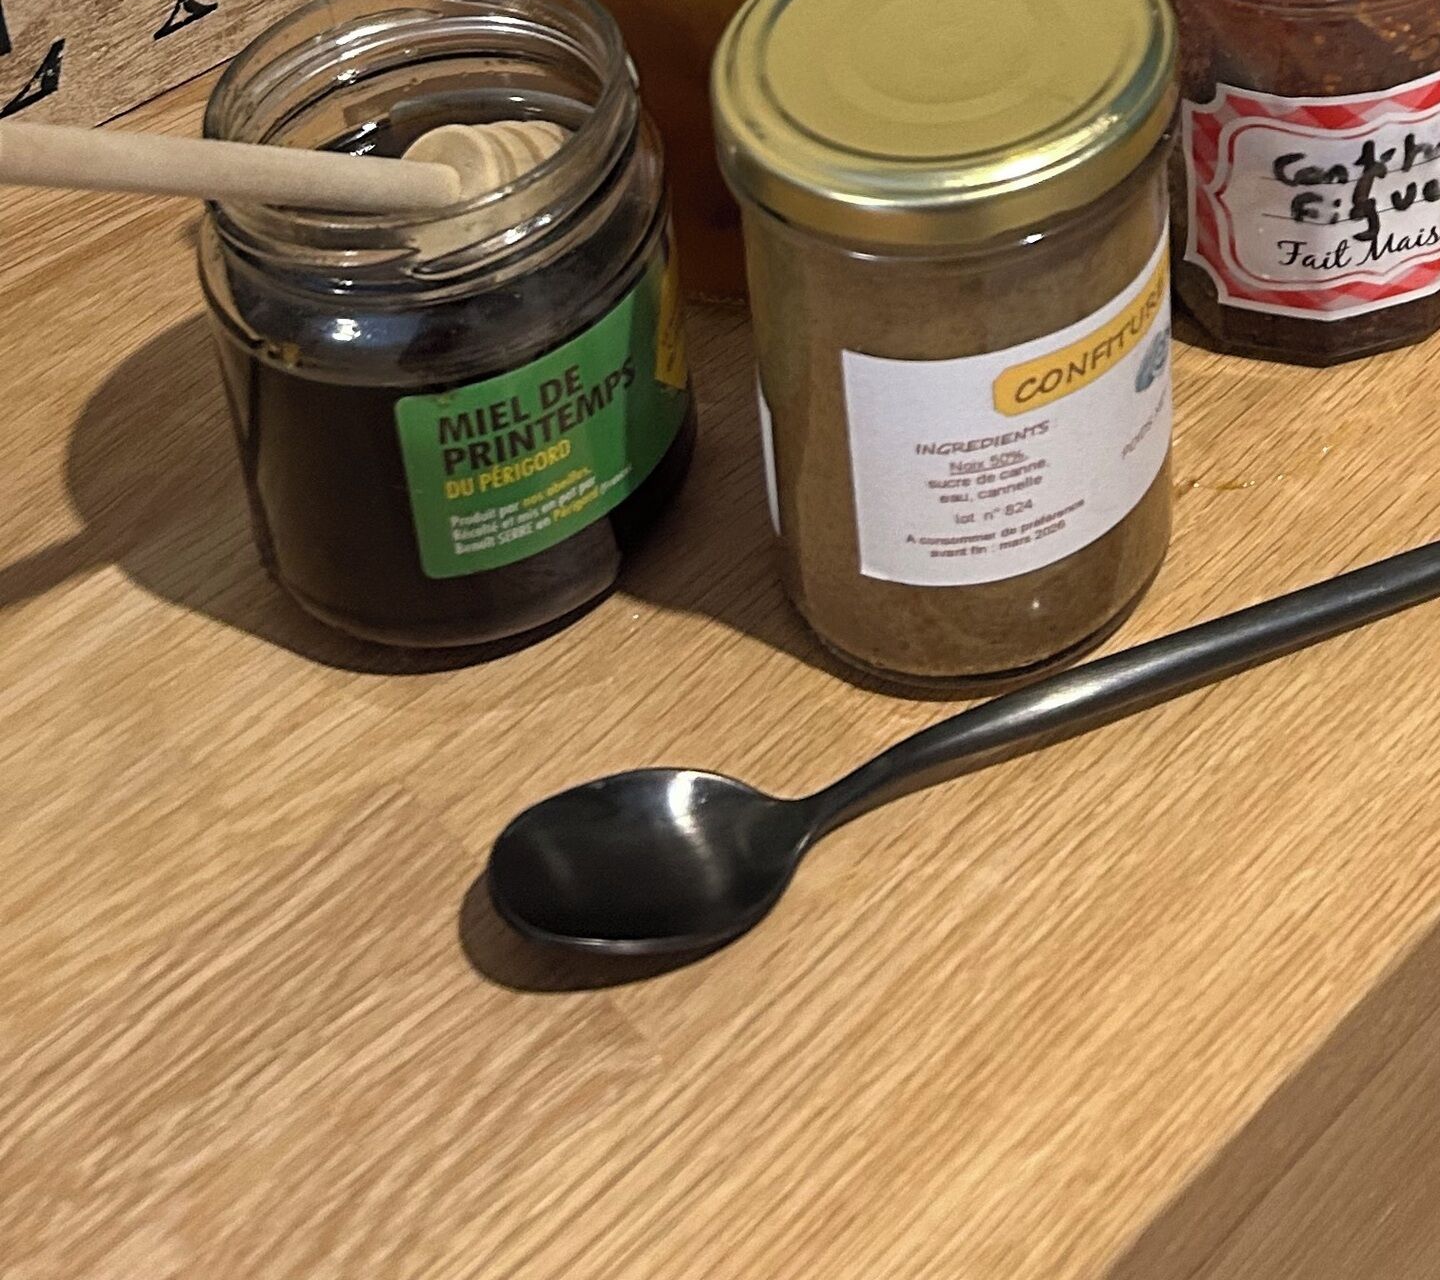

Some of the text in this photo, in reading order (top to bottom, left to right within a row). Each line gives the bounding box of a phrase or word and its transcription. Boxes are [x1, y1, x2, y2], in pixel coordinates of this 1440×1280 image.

[1277, 238, 1353, 270] Fait
[437, 363, 584, 445] MIEL DE
[442, 356, 636, 476] PRINTEMPS
[916, 419, 1051, 456] INGREDIENTS
[444, 439, 572, 500] DU PÉRIGORD
[928, 477, 972, 489] sucre
[976, 471, 996, 485] de
[950, 458, 985, 476] Noix
[977, 475, 1043, 500] cannelle
[955, 512, 976, 525] lot
[1004, 498, 1034, 517] 824
[906, 534, 917, 545] A
[919, 532, 996, 546] consommer
[1000, 526, 1018, 538] de
[930, 548, 967, 558] avant
[970, 544, 988, 556] fin
[1000, 535, 1032, 550] mars
